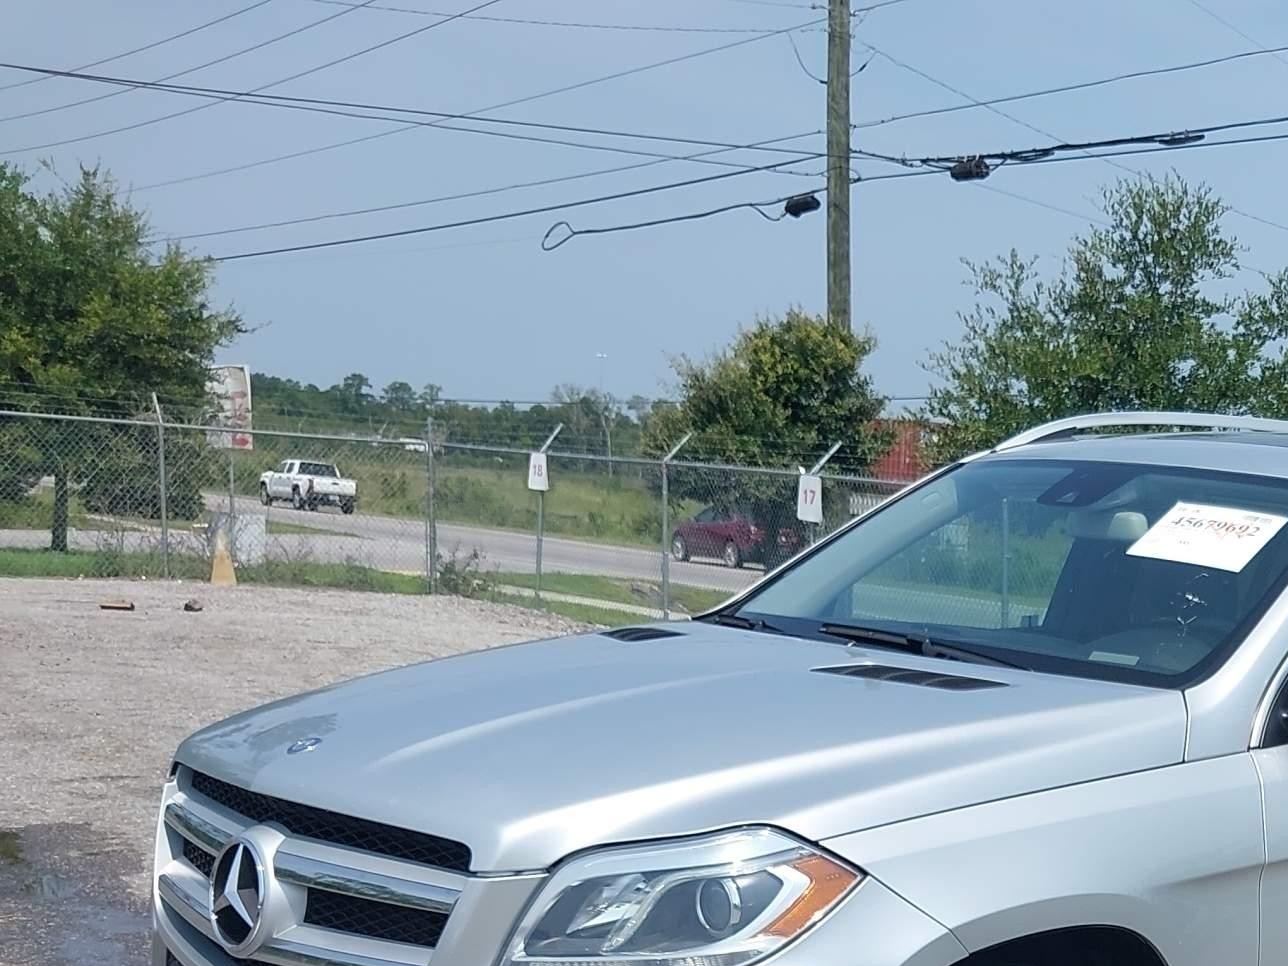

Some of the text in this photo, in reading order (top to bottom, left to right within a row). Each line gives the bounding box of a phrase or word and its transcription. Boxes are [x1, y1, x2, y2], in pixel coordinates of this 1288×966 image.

[533, 464, 543, 477] 18
[804, 489, 816, 505] 17
[1171, 516, 1260, 538] 45679692
